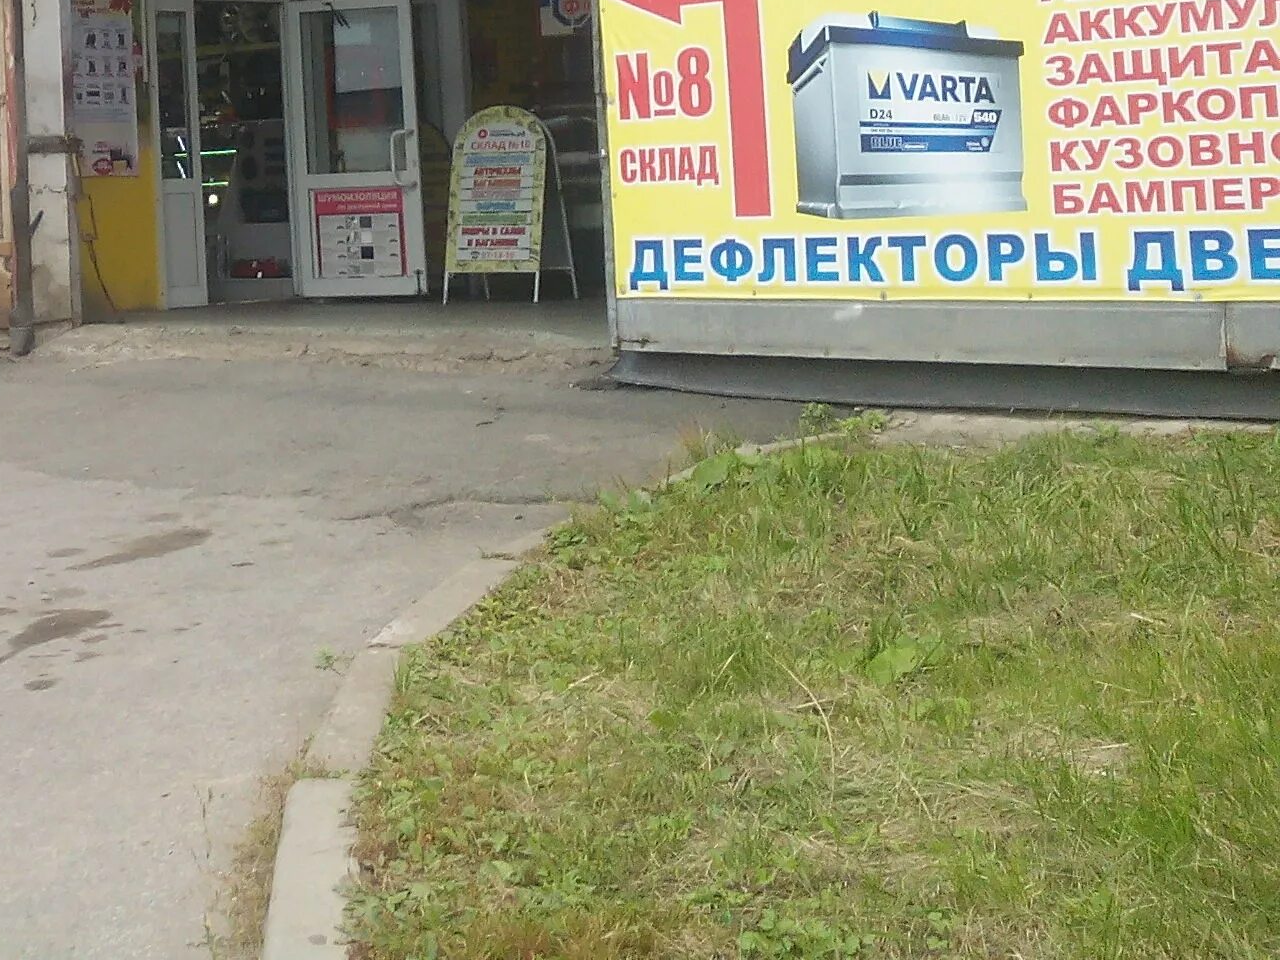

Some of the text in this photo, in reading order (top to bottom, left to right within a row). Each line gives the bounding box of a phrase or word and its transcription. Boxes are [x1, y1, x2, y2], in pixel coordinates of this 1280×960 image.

[615, 48, 713, 121] №8
[896, 71, 996, 104] VARTA
[869, 108, 893, 120] D24
[1047, 86, 1279, 129] ФАРКОП
[620, 145, 720, 187] СКЛАД
[1052, 177, 1280, 215] БАМПЕР
[629, 231, 1097, 291] ДЕФЛЕКТОРЫ
